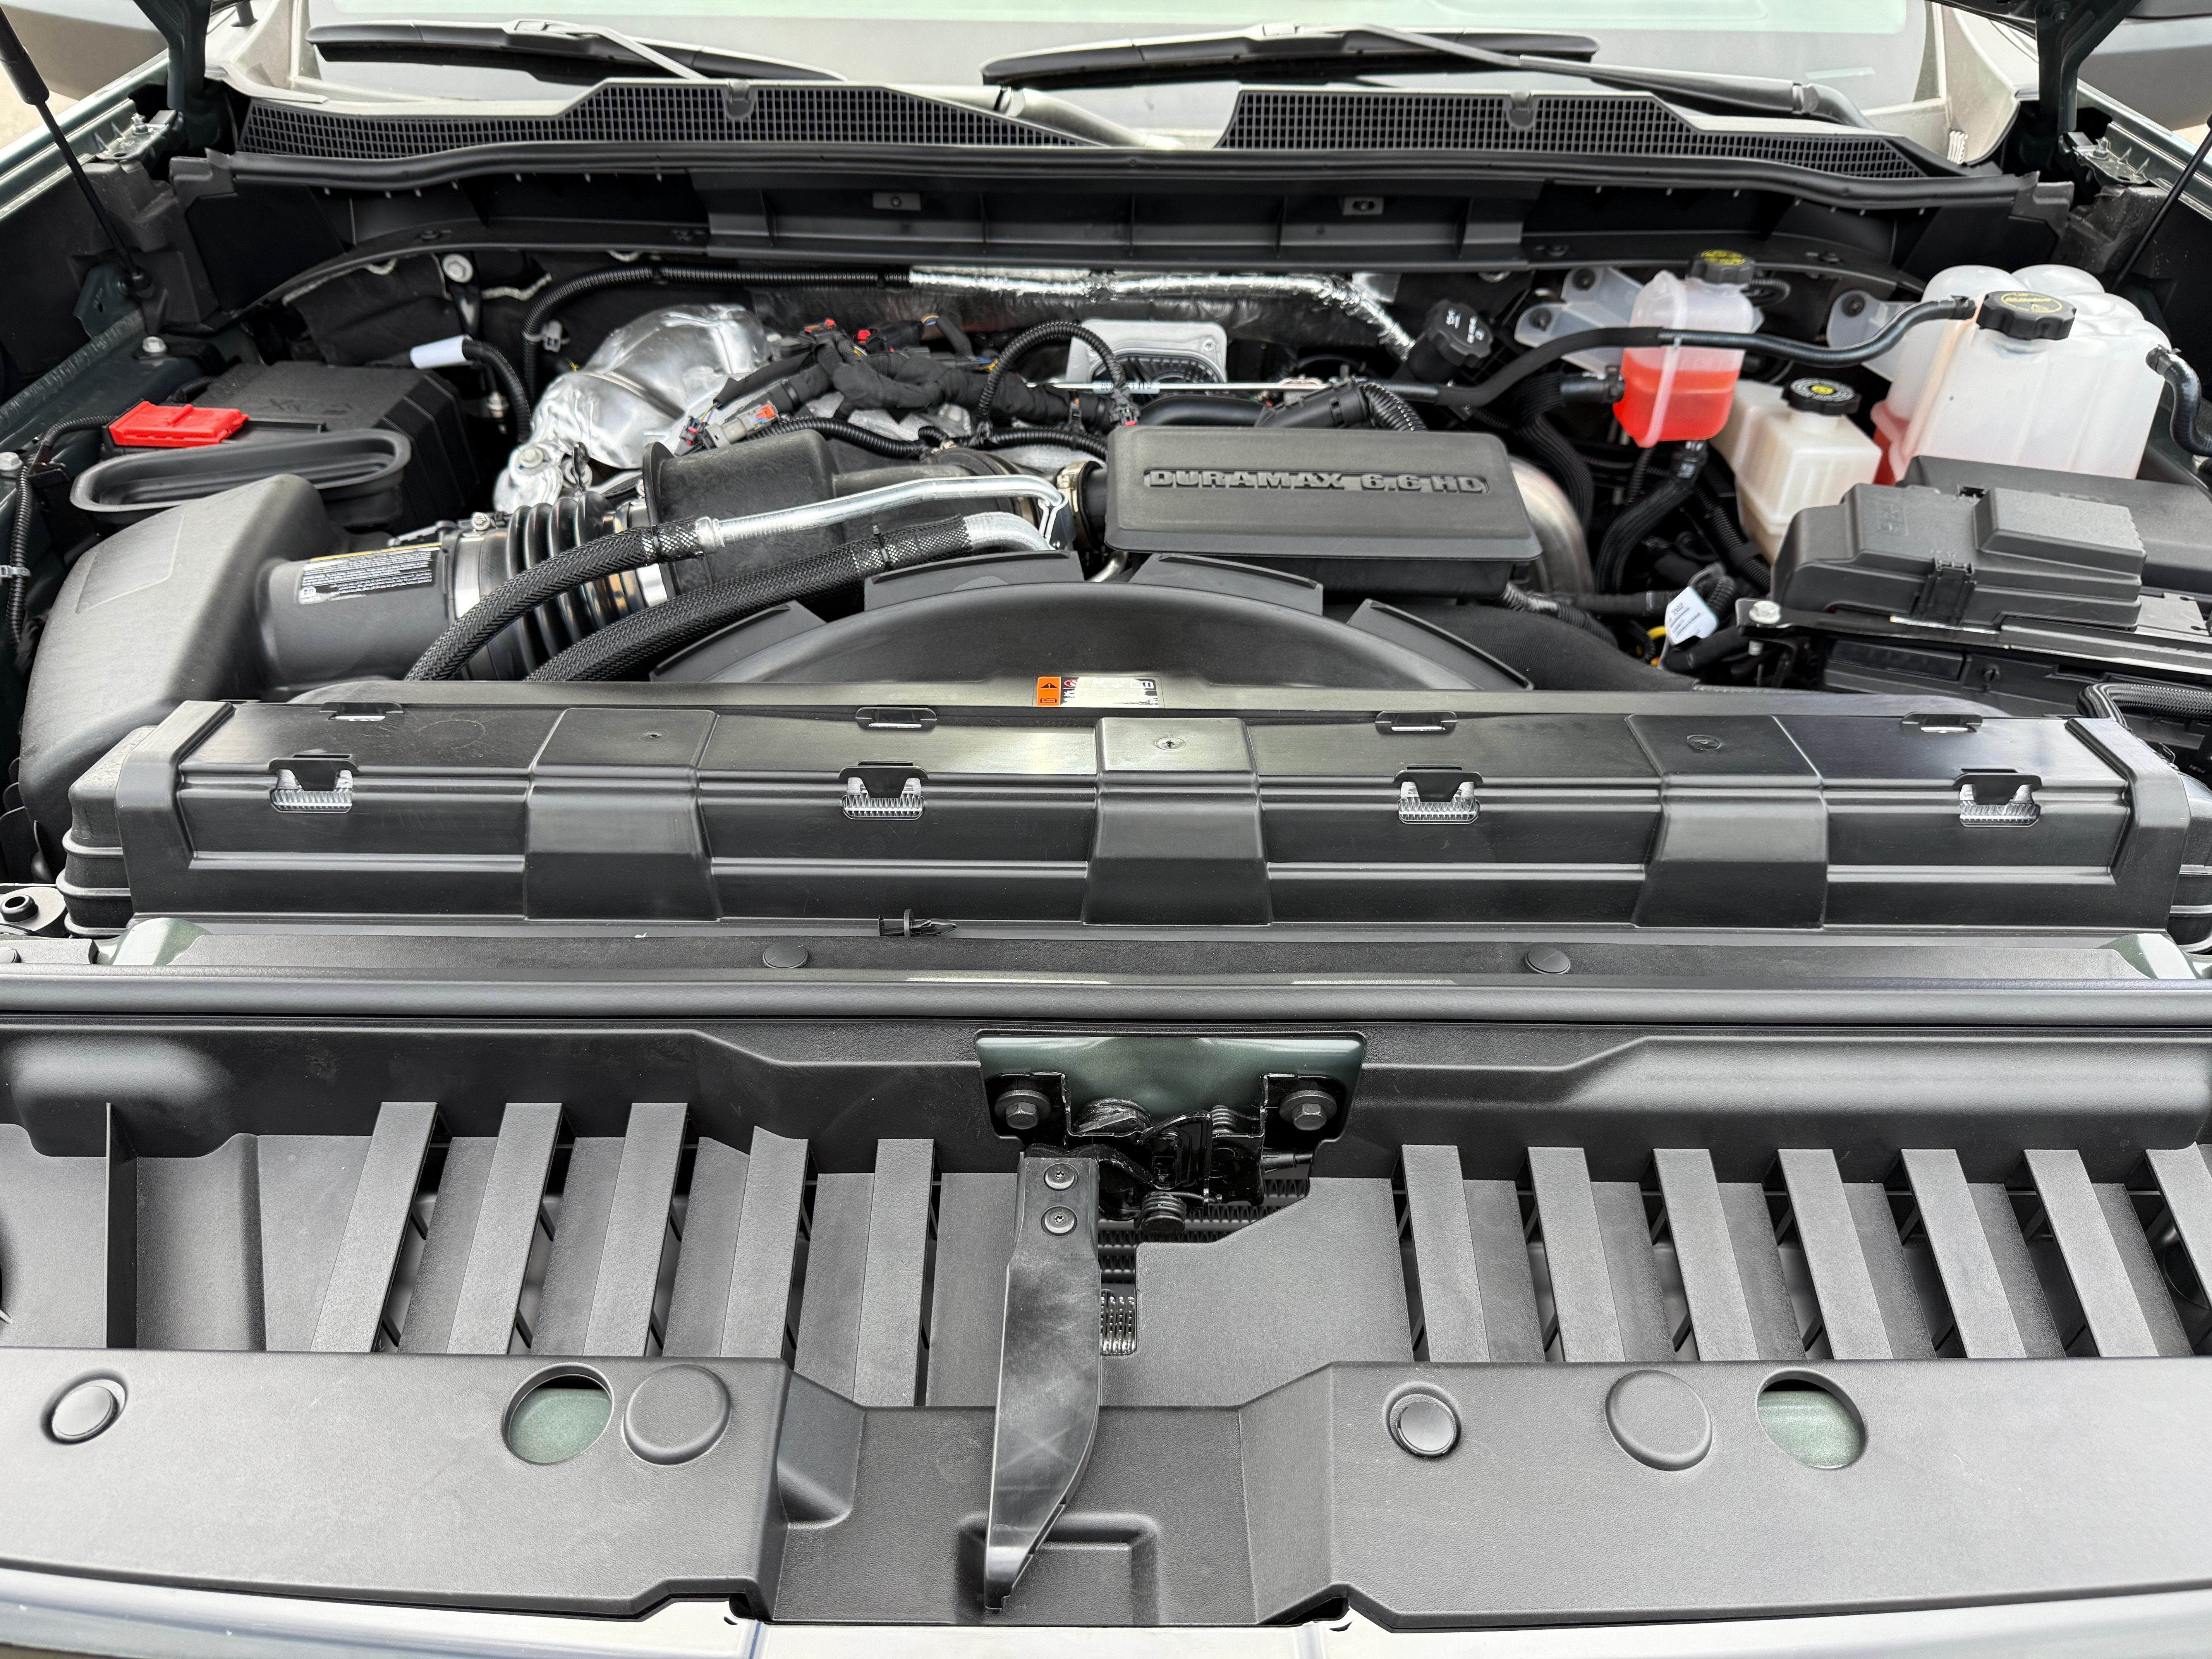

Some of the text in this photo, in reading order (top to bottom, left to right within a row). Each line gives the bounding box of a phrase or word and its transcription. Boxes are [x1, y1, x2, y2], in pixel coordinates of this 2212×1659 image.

[1149, 471, 1484, 494] DURAMAX 6.6 HD
